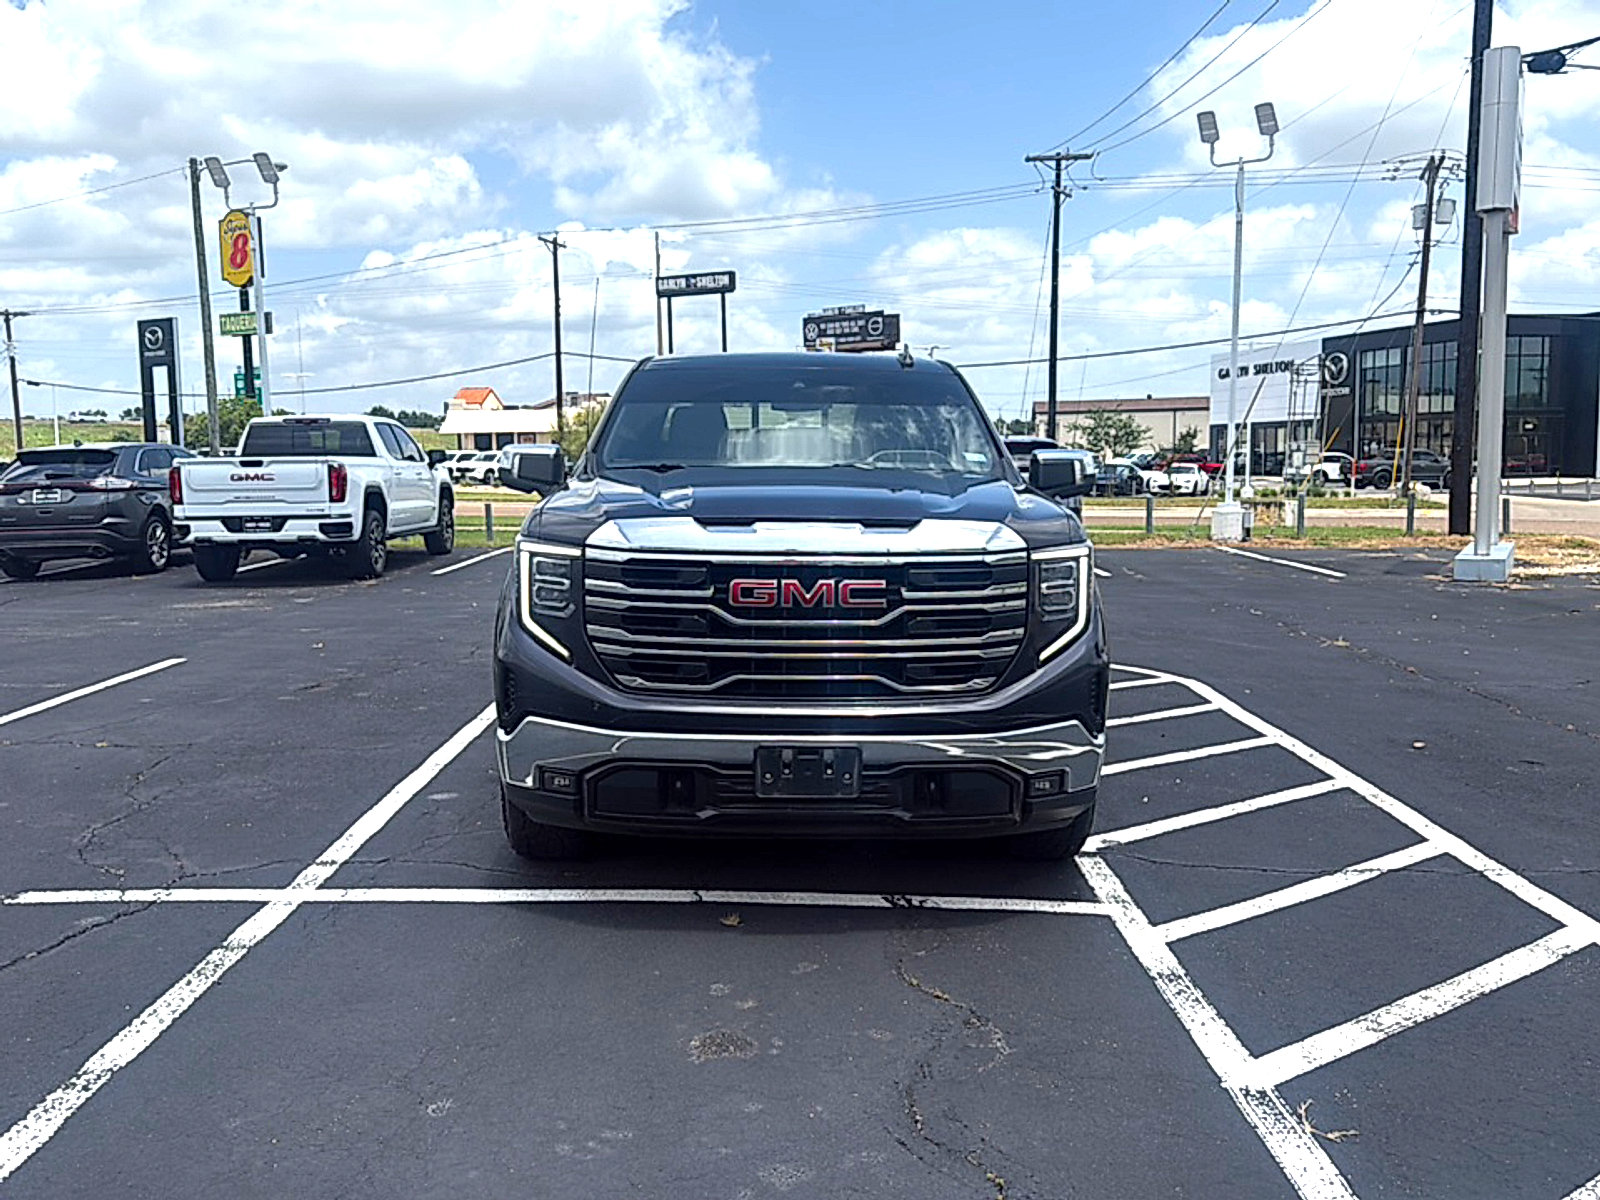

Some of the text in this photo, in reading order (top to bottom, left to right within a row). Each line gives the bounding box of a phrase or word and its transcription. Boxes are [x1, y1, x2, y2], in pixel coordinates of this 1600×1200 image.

[230, 233, 249, 269] 8
[230, 473, 276, 482] GMC
[729, 578, 888, 608] GMC
